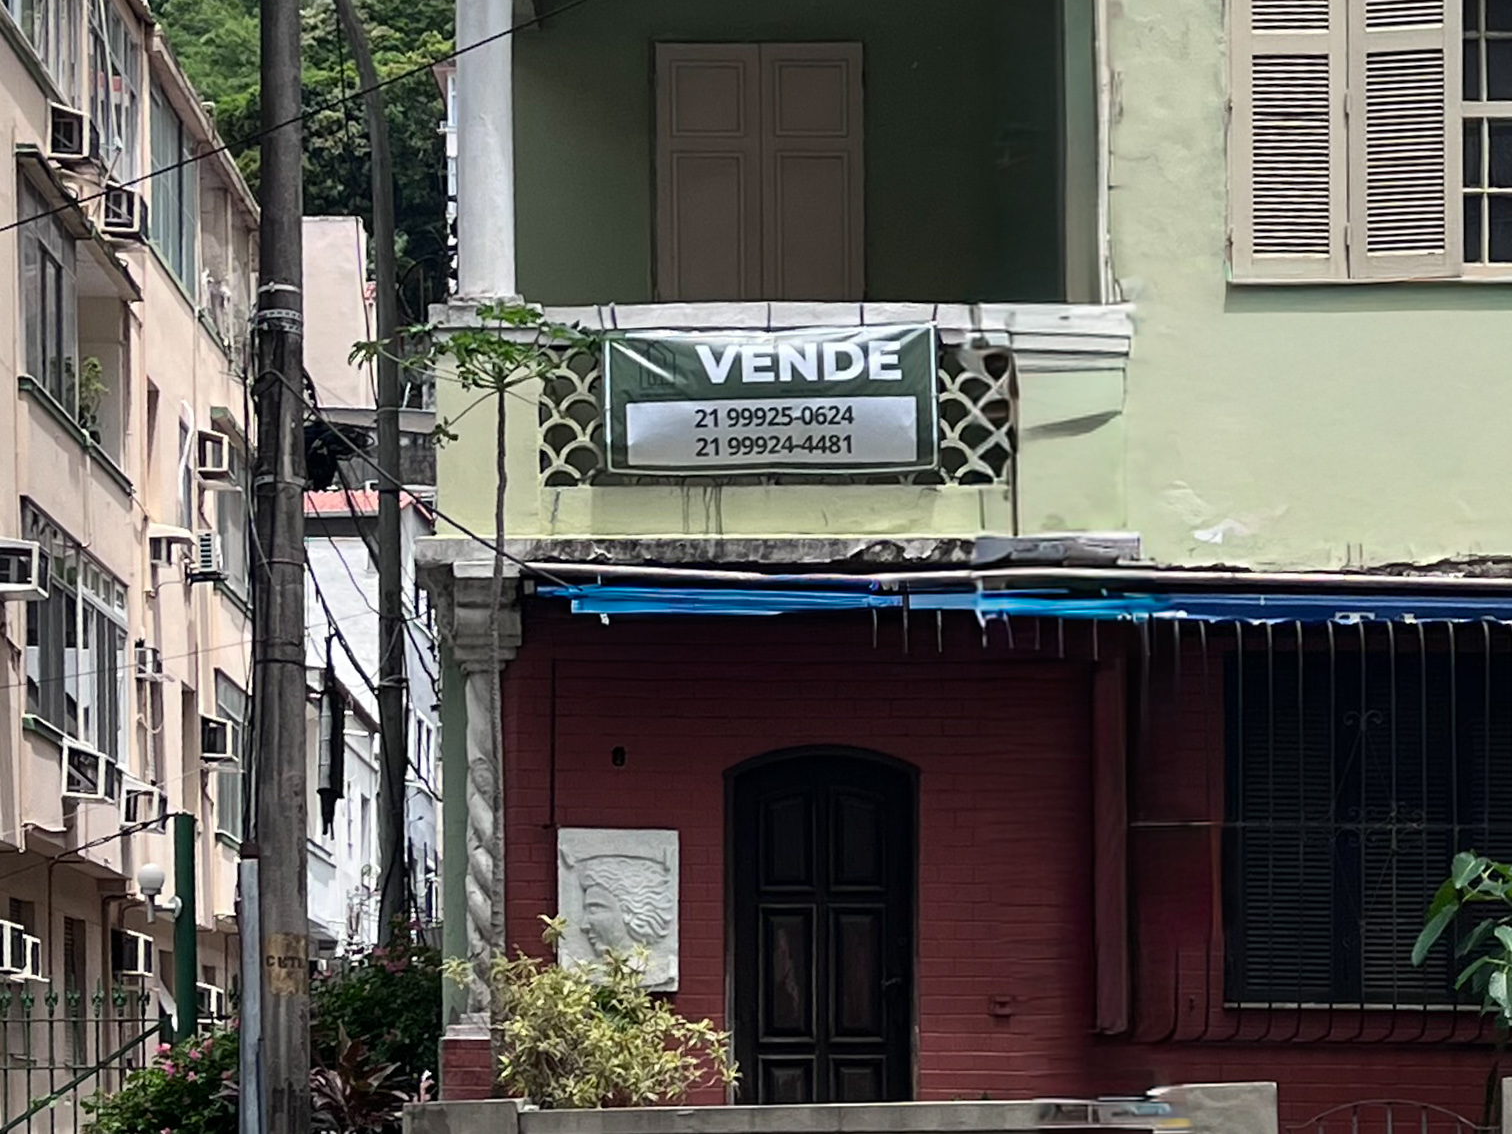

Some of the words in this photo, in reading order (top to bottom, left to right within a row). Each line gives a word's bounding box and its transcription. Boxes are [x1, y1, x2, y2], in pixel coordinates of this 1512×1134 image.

[695, 342, 903, 384] VENDE
[694, 409, 719, 428] 21
[726, 405, 855, 427] 99925-0624
[695, 437, 720, 457] 21
[727, 434, 853, 456] 99924-4481
